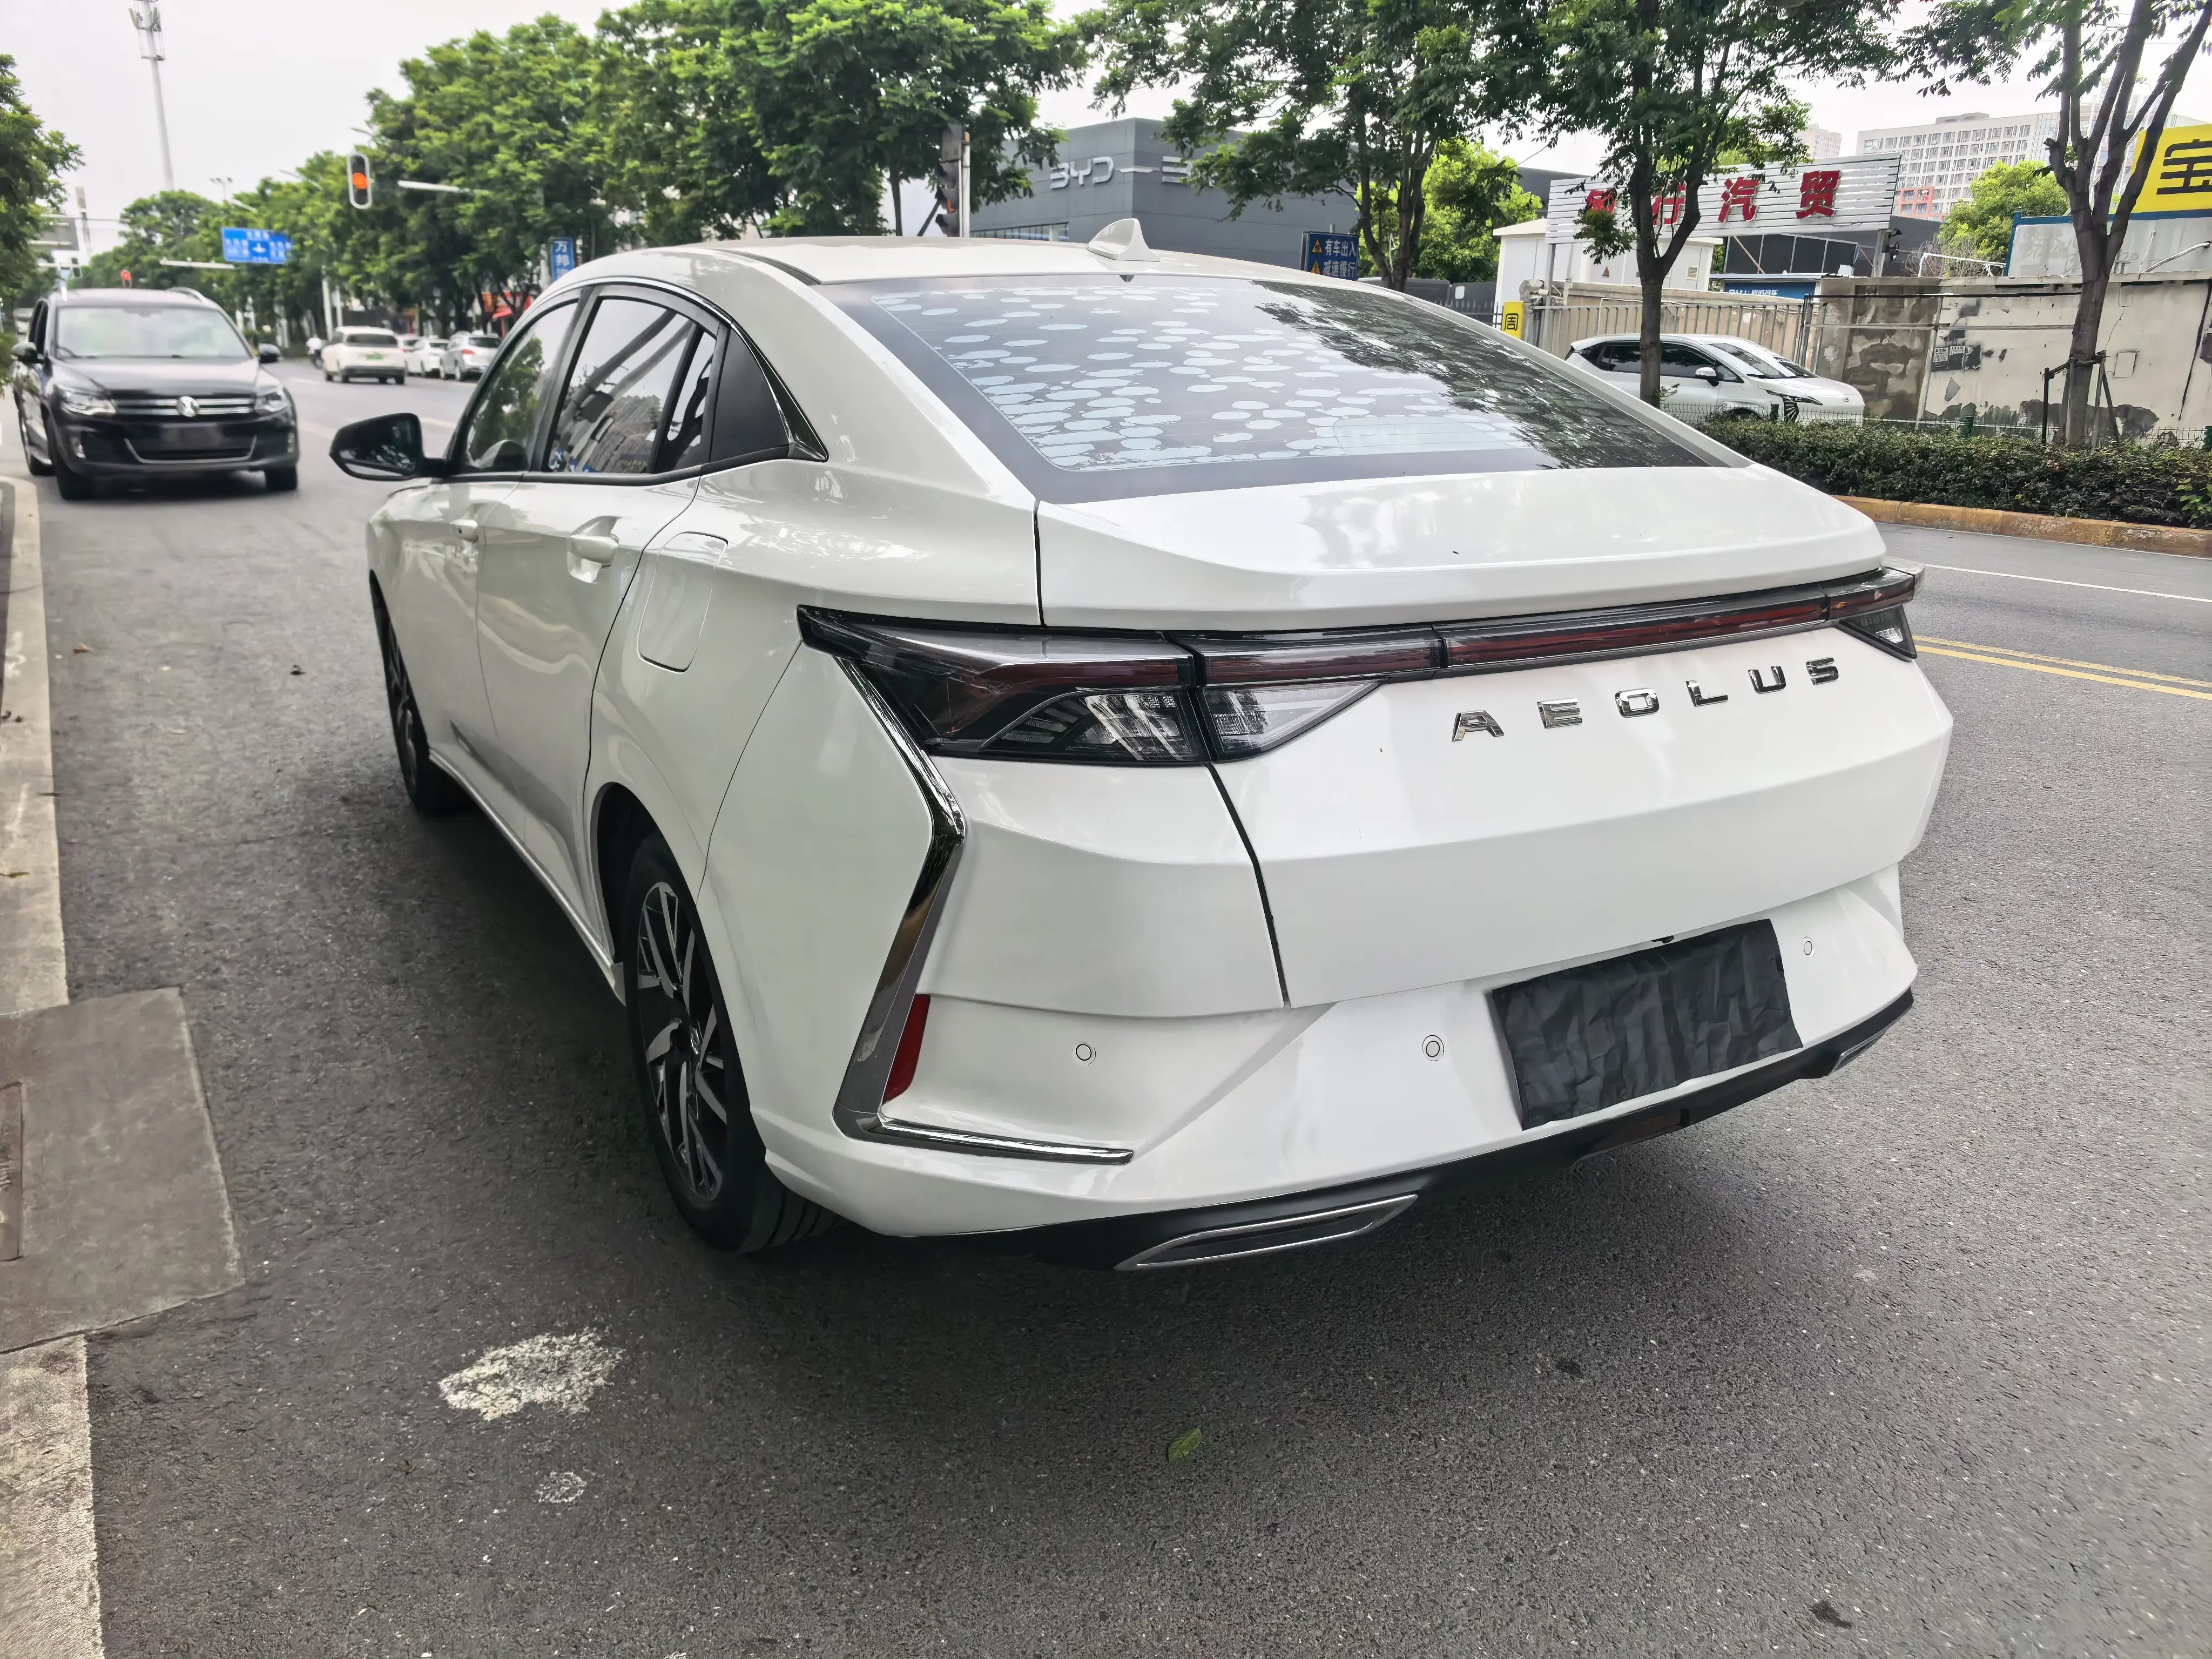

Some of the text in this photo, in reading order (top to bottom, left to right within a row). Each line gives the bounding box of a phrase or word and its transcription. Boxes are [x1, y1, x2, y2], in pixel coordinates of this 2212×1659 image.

[1050, 157, 1114, 190] BYD
[2156, 139, 2212, 195] 宝
[1325, 239, 1357, 257] 有车出入
[1503, 313, 1519, 332] 周
[1452, 656, 1839, 742] AEOLUS
